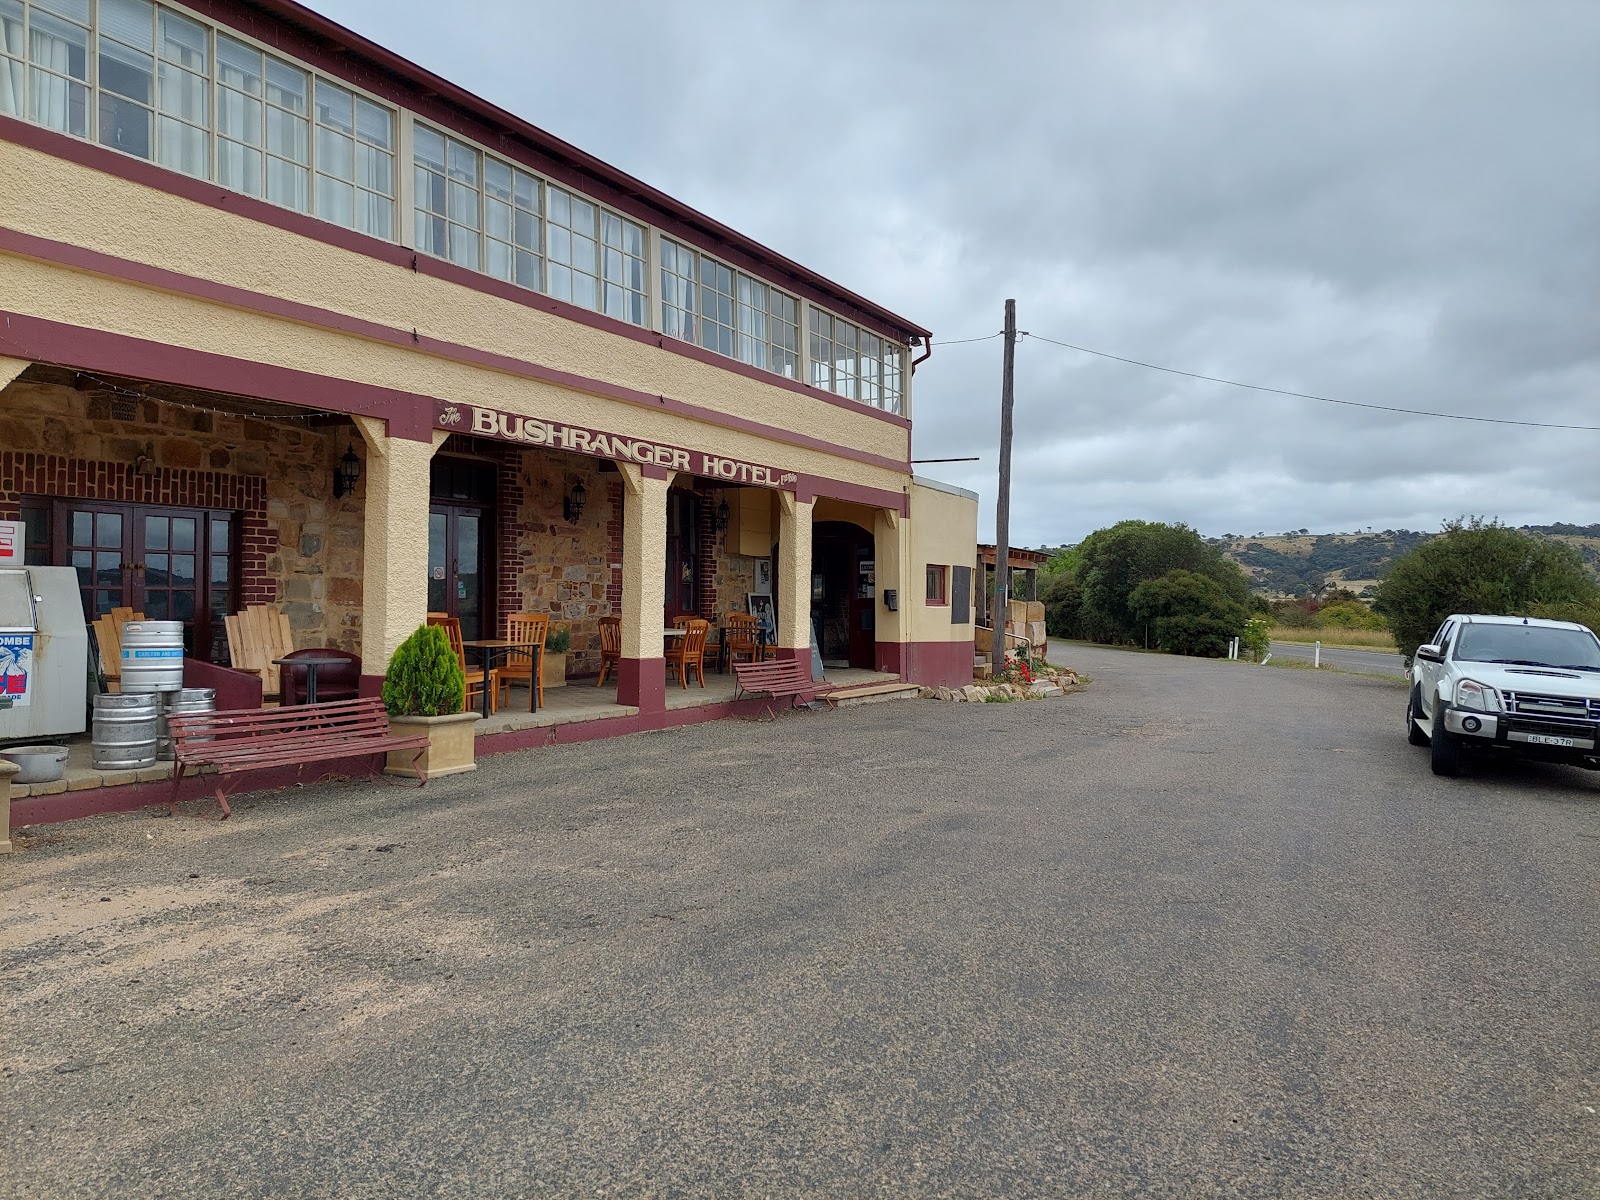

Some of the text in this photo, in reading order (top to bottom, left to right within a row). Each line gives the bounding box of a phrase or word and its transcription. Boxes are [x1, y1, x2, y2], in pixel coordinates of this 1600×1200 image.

[438, 406, 461, 426] The
[471, 406, 691, 471] BUSHRANGER
[702, 455, 780, 486] HOTEL
